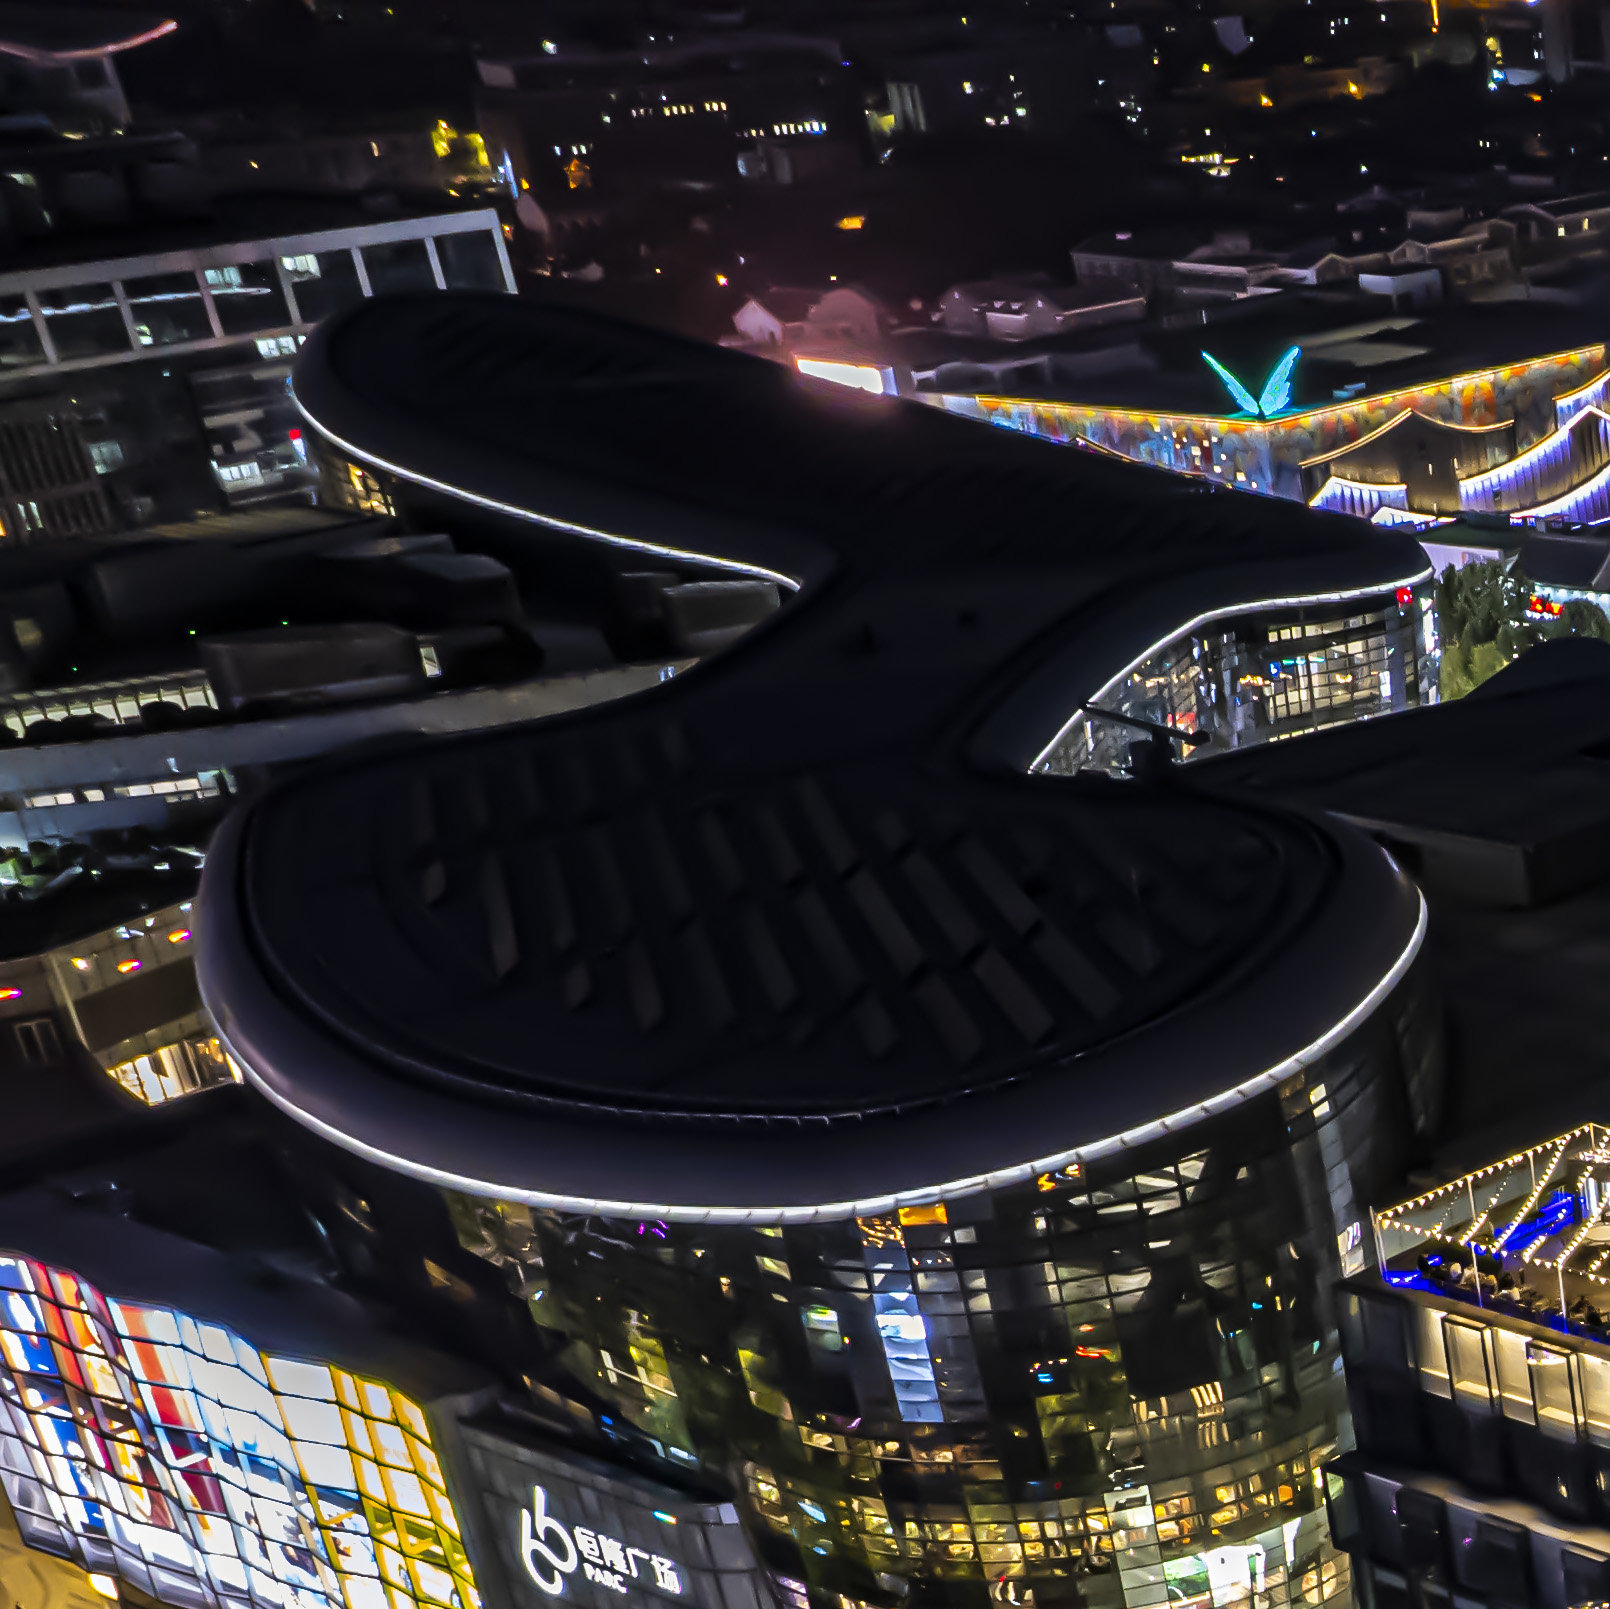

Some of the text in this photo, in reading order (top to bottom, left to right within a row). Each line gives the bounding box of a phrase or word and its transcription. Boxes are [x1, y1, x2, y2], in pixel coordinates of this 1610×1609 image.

[573, 1525, 682, 1595] 恒隆广场
[582, 1562, 628, 1594] PARC
